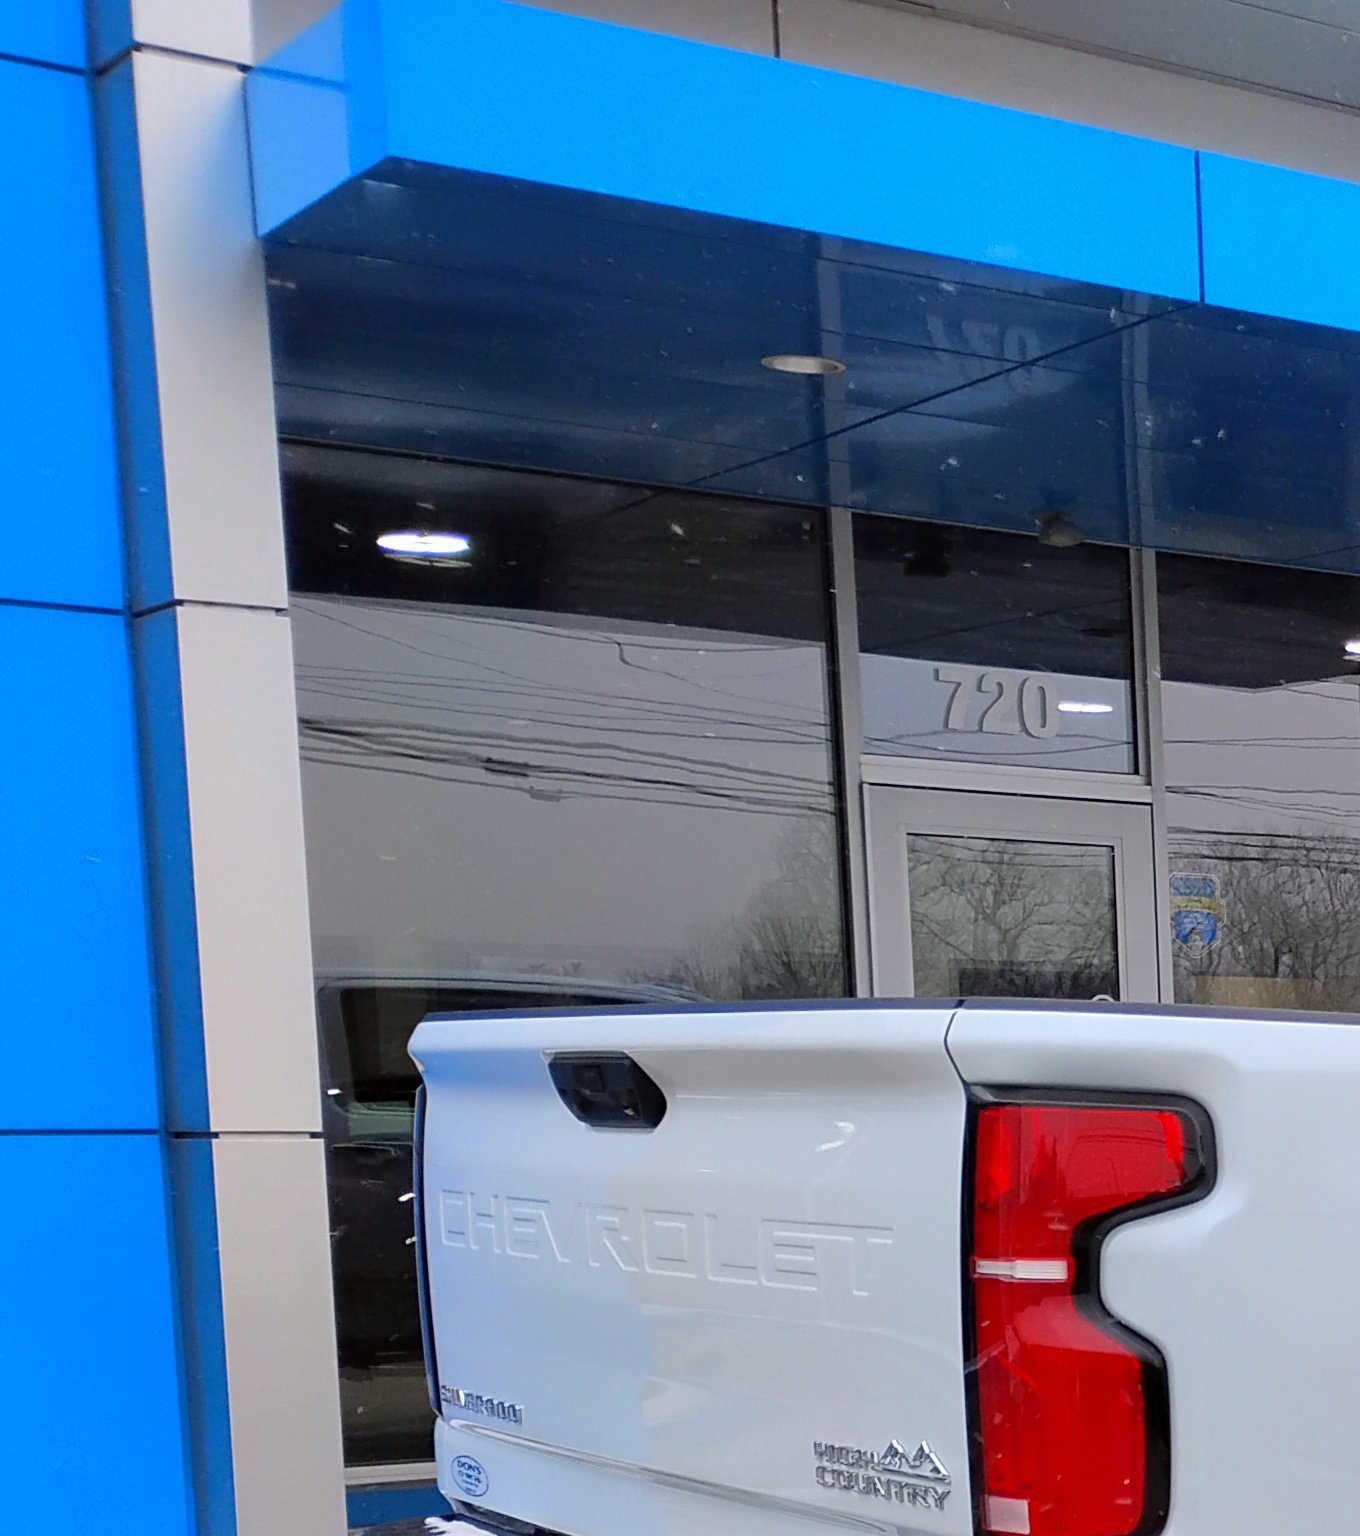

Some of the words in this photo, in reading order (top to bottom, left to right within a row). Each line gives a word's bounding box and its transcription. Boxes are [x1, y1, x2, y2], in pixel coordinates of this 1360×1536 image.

[932, 667, 1060, 739] 720
[439, 1188, 895, 1297] CHEVROLET
[814, 1465, 951, 1511] COUNTRY
